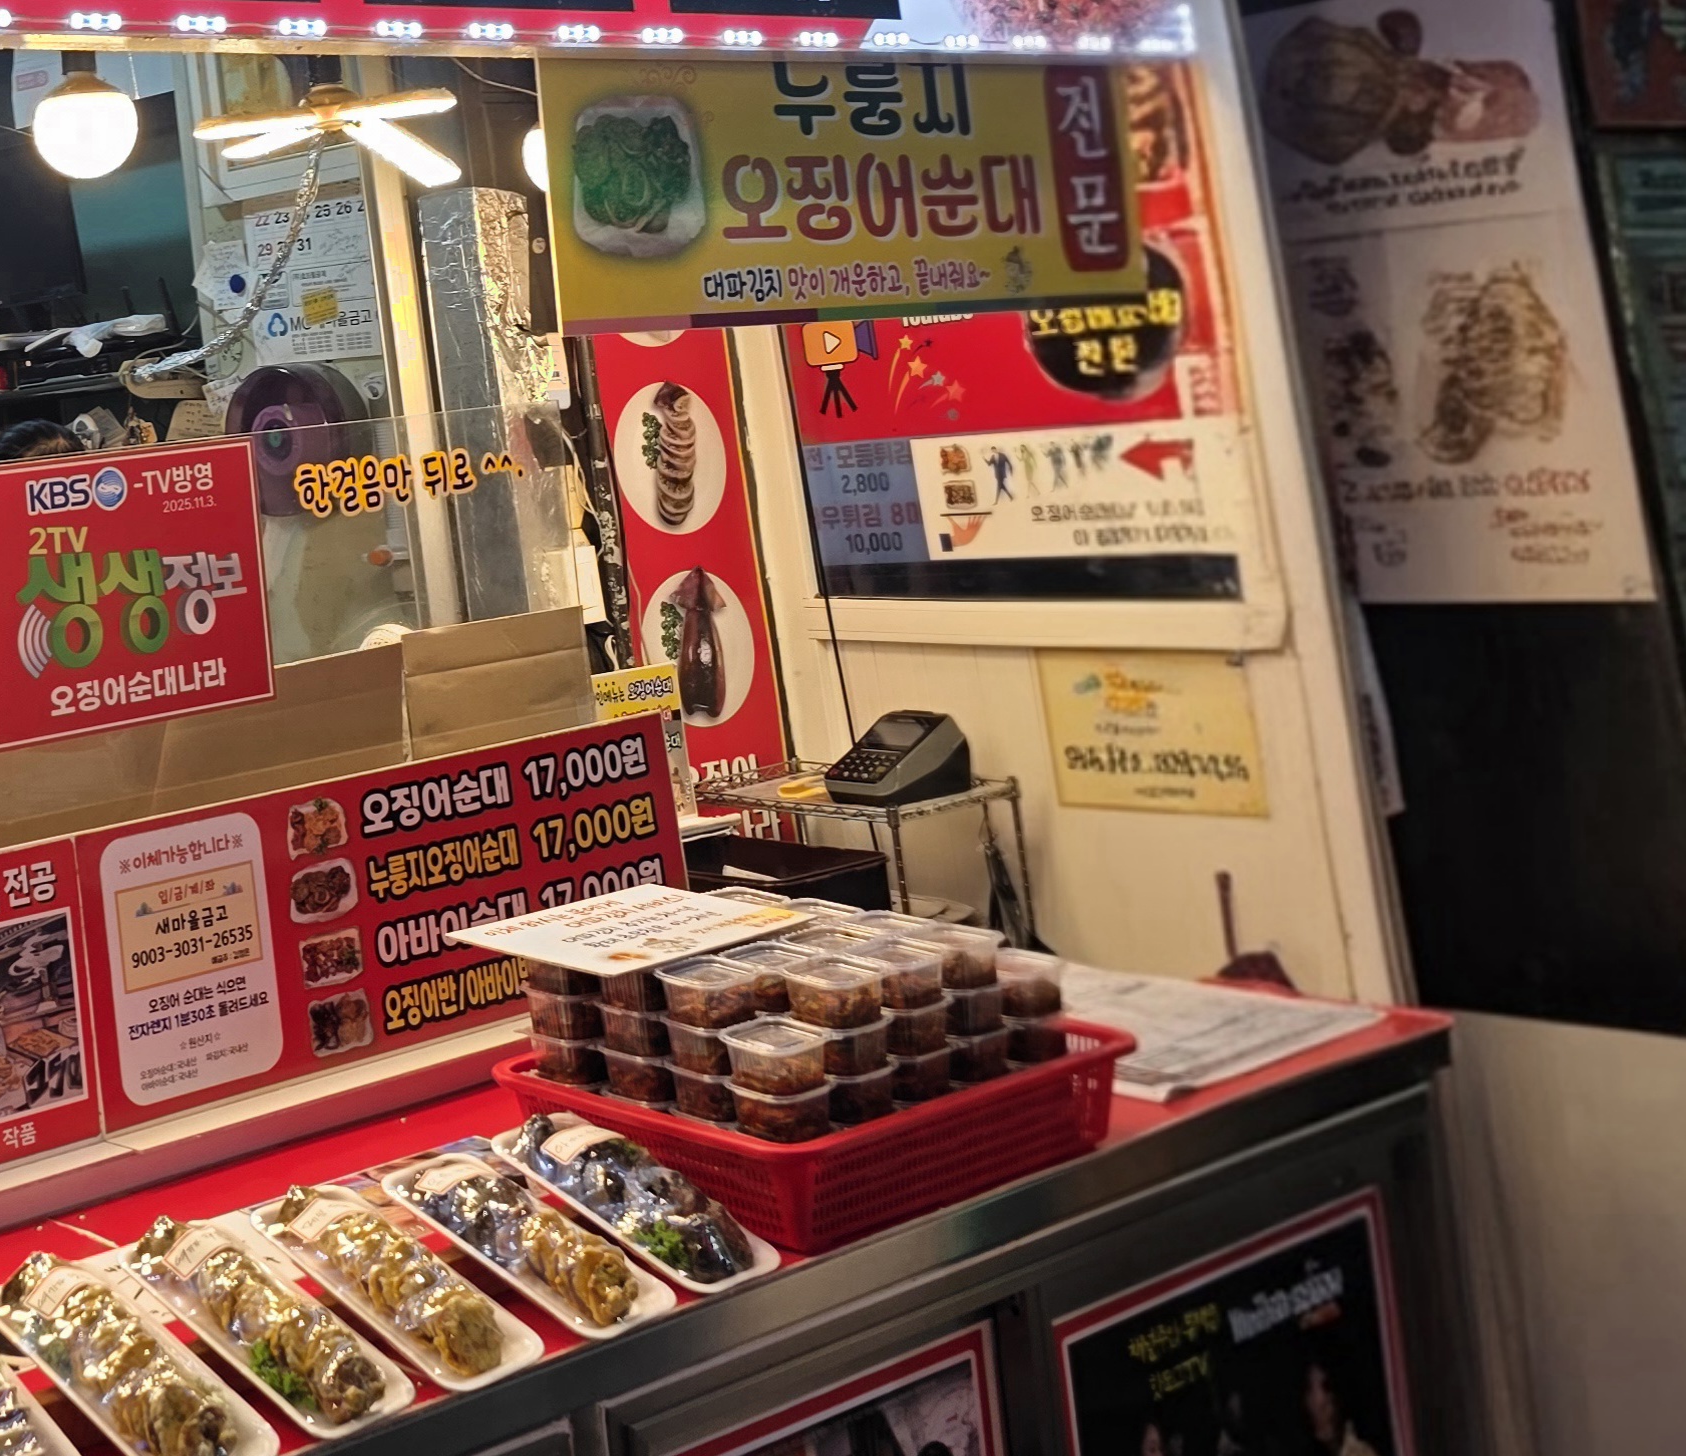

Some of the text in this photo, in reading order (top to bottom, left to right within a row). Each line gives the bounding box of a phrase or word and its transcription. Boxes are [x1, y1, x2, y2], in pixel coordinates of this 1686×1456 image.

[1057, 76, 1119, 254] 전문
[336, 201, 353, 217] 26
[257, 243, 273, 257] 29
[297, 237, 312, 252] 31
[703, 268, 783, 302] 대파김치
[788, 272, 826, 300] 맛이
[25, 474, 92, 515] KBS
[293, 451, 414, 519] 한걸음만
[420, 446, 478, 498] 뒤로
[840, 471, 891, 496] 2,800
[815, 504, 883, 530] 우튀김
[28, 526, 89, 556] 2TV
[845, 531, 905, 555] 10,000
[17, 548, 248, 669] 생생정보
[49, 657, 228, 718] 오징어순대나라
[362, 735, 648, 836] 오징어순대 17,000원
[367, 794, 657, 900] 누룽지오징어순대 17,000원
[2, 860, 57, 908] 전공
[157, 878, 216, 906] 입/금/계/좌
[154, 904, 229, 936] 새마을금고
[130, 923, 254, 969] 9003-3031-26535
[148, 975, 247, 1014] 오징어 순대는 식으면
[127, 990, 270, 1041] 전자렌지 1분30초 돌려드세요
[2, 1121, 37, 1149] 작품
